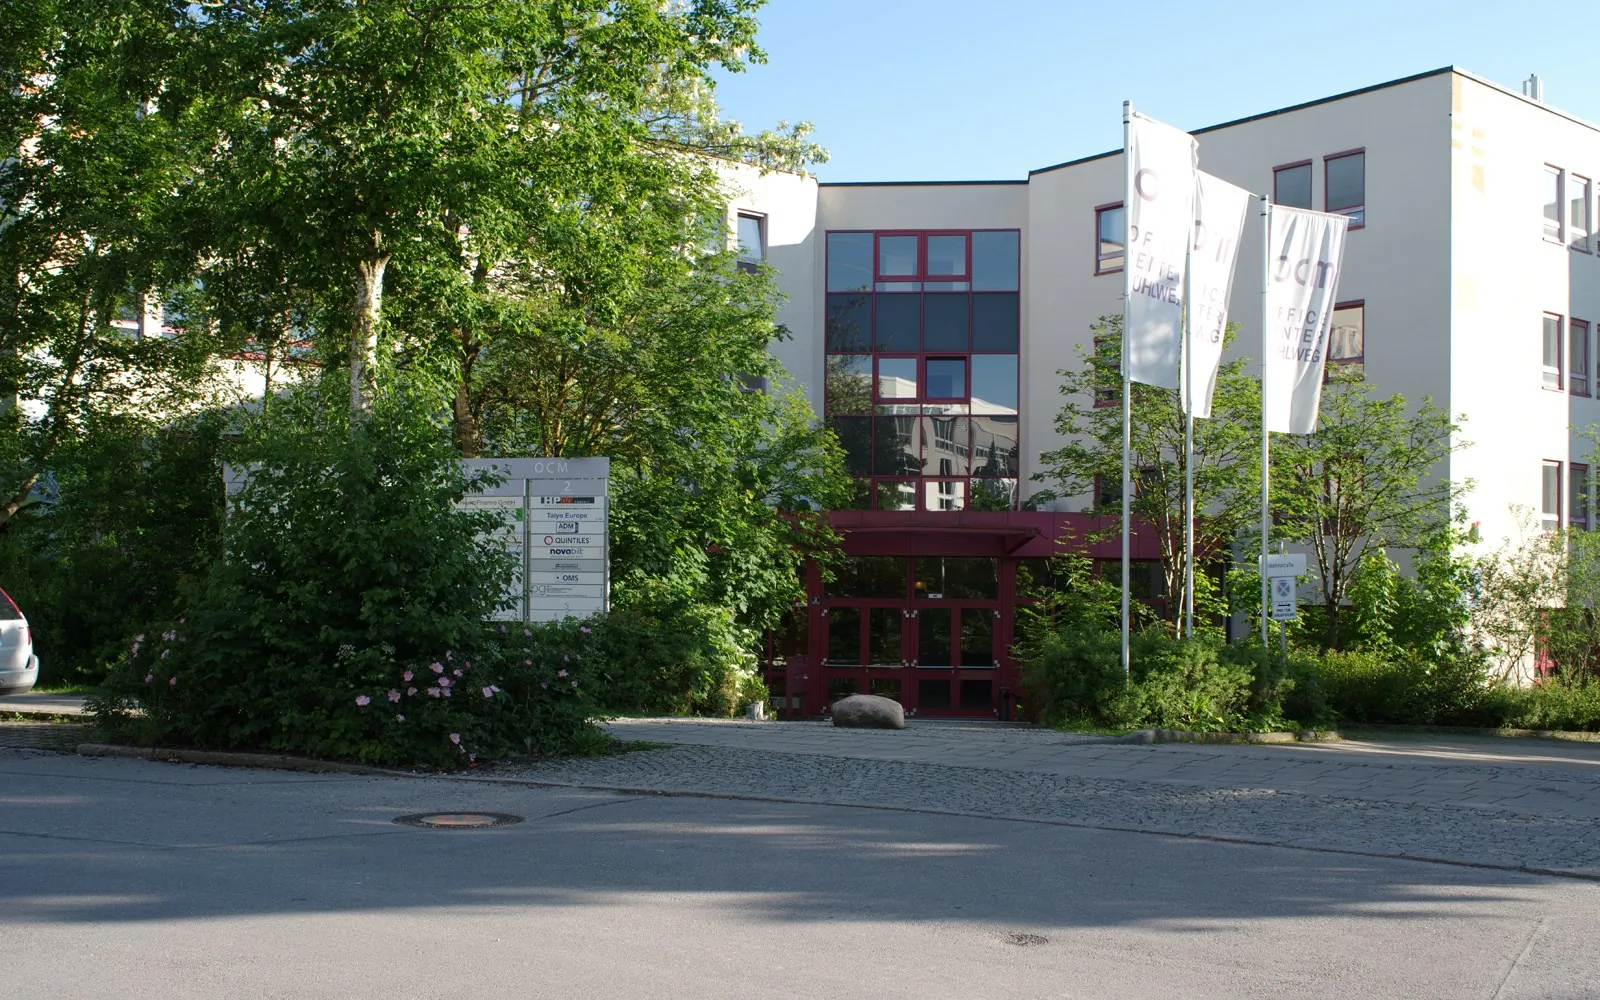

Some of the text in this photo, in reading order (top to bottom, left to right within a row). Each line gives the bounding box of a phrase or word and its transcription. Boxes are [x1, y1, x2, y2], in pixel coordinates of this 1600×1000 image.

[534, 461, 568, 474] OCM
[563, 480, 571, 492] 2
[547, 512, 564, 520] Taiyo
